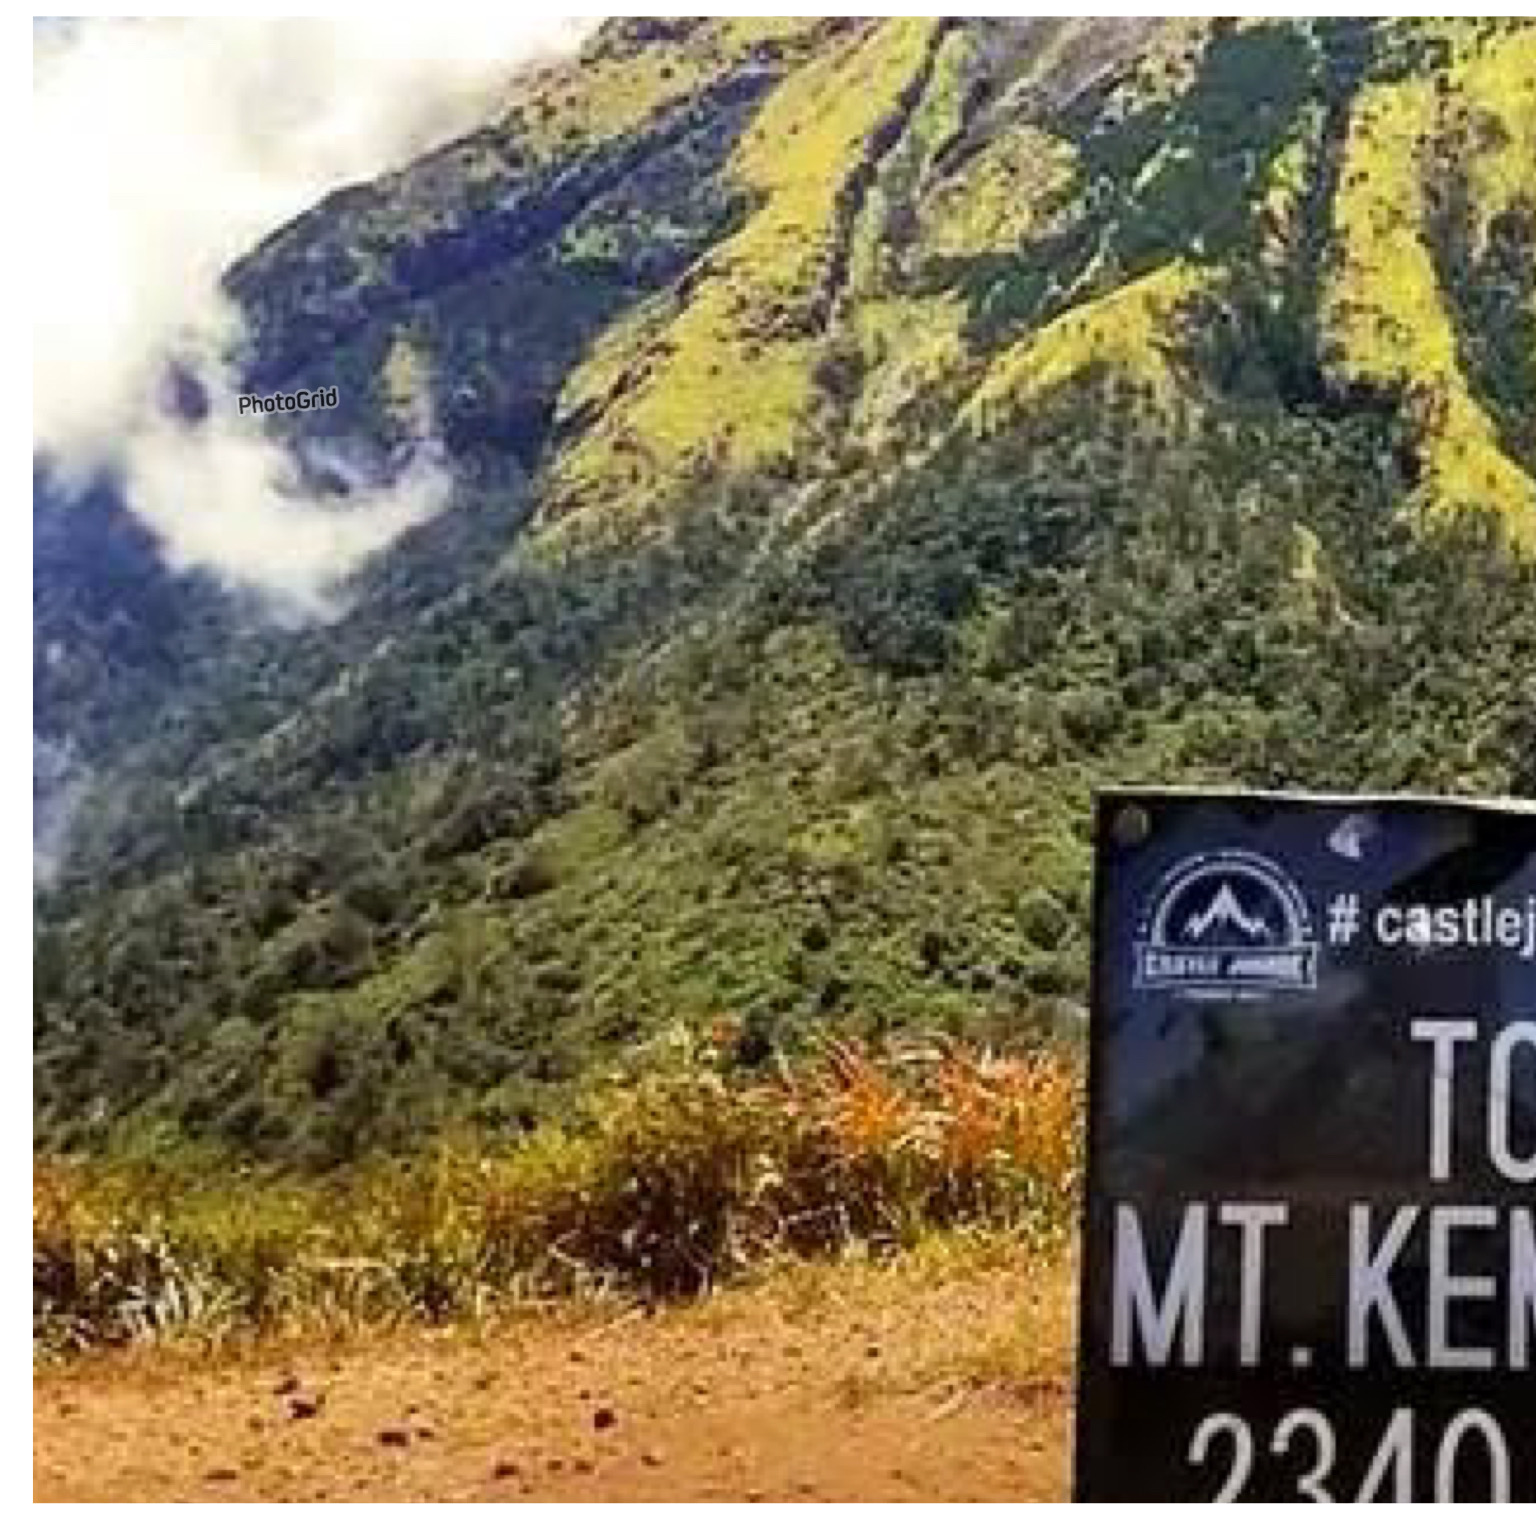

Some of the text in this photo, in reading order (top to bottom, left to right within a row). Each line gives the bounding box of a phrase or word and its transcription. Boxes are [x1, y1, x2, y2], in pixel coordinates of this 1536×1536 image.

[1327, 892, 1361, 944] #
[1108, 1202, 1311, 1367] MT.
[1188, 1407, 1511, 1503] 2340
